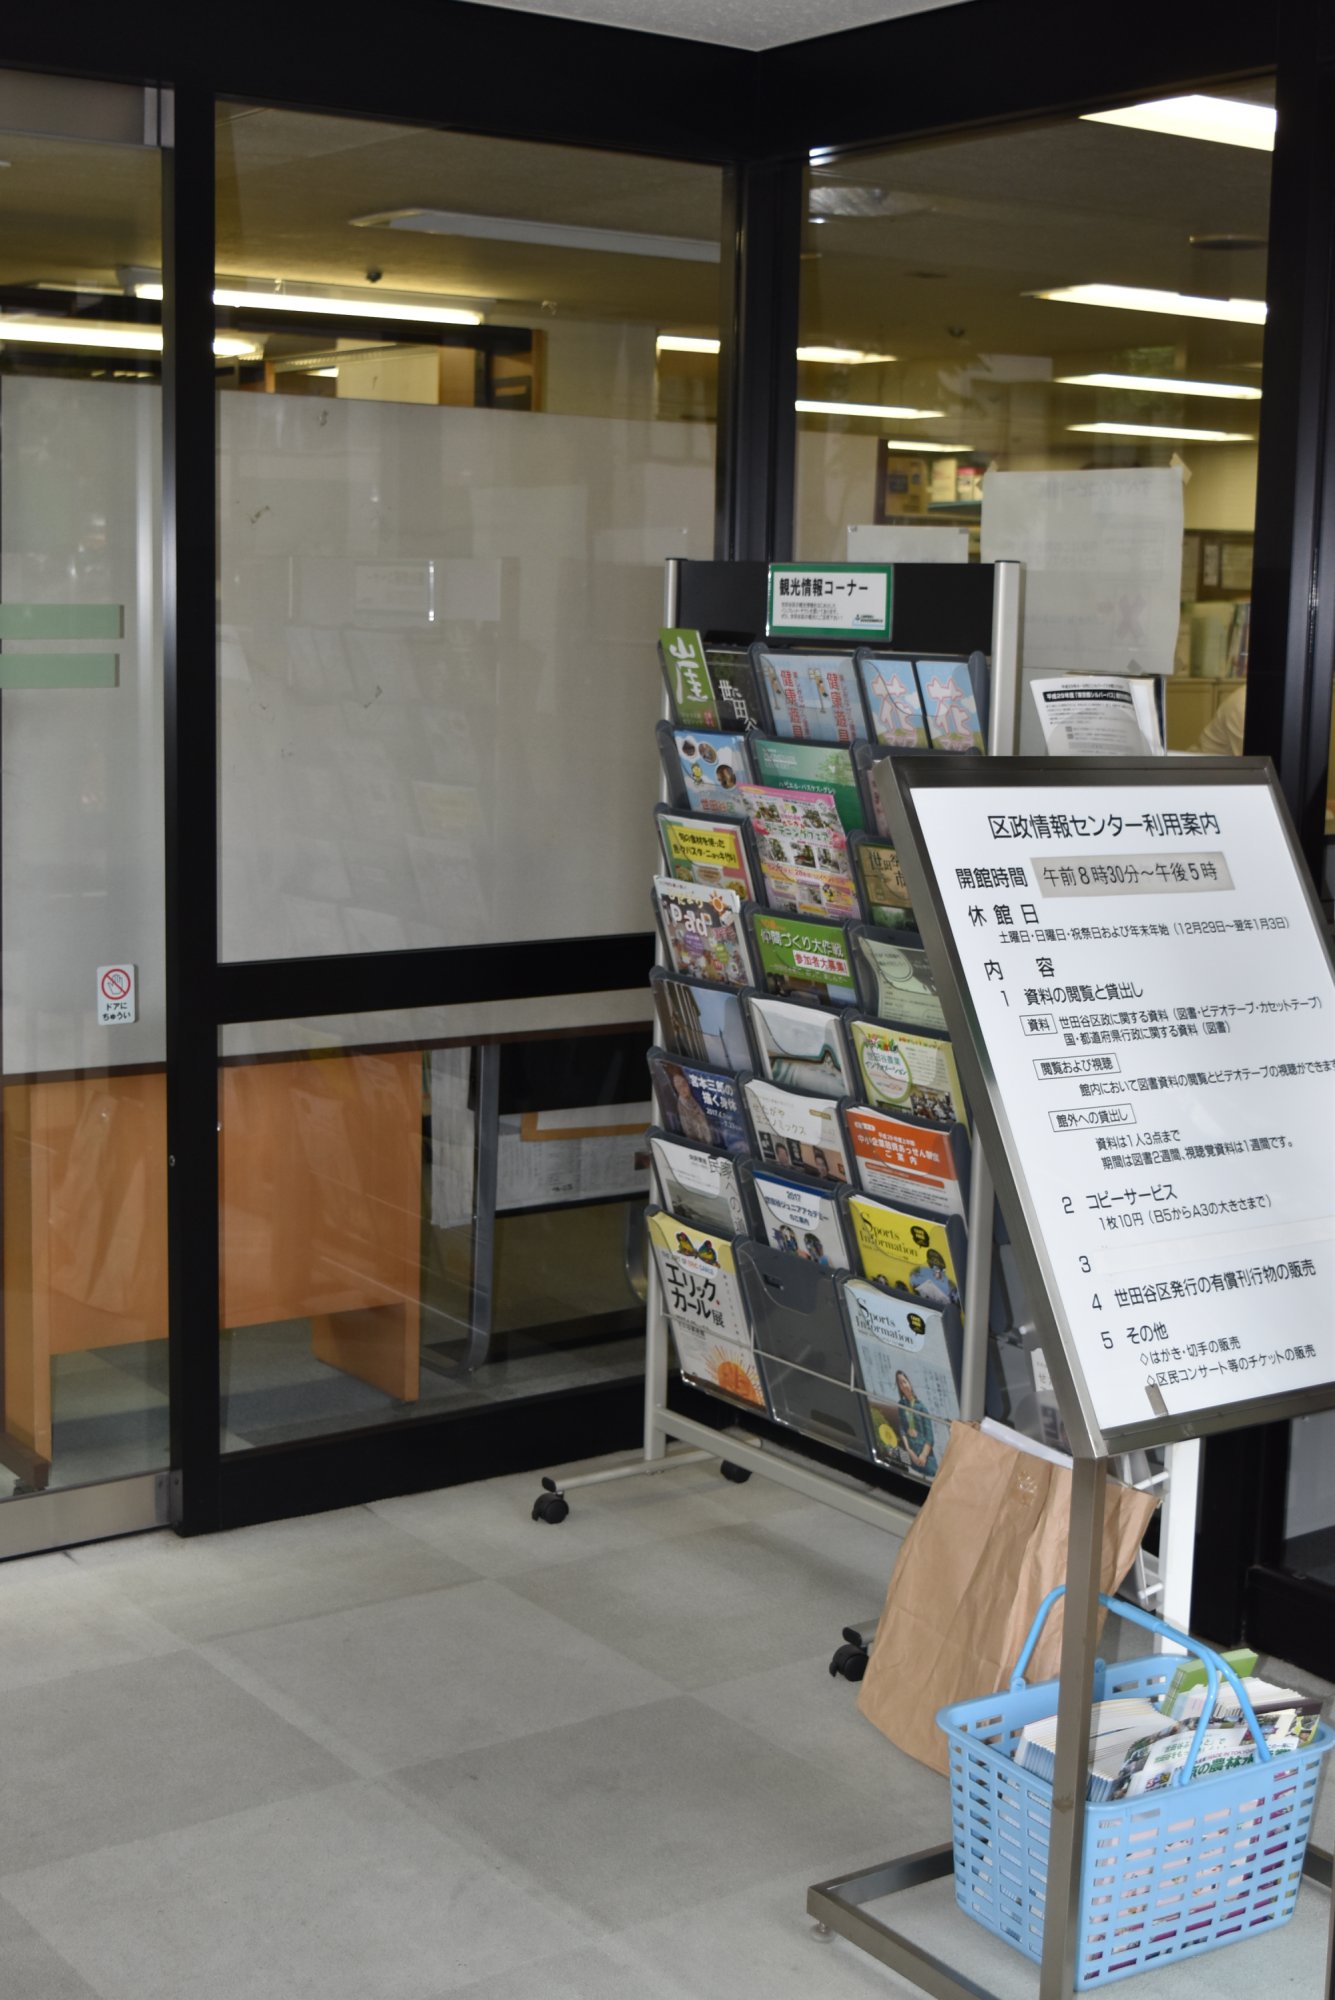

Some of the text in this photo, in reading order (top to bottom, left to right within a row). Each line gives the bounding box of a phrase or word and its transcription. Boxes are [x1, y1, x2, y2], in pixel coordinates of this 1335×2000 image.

[779, 578, 868, 597] 観光情報コーナー
[987, 811, 1221, 840] 区政情報センター利用案内
[955, 866, 1029, 890] 開館時間
[106, 1002, 128, 1010] ドアに
[1000, 980, 1144, 1007] 1 資料の閲覧と貸出し
[102, 1011, 131, 1021] ちゅうい
[1026, 1016, 1052, 1033] 資料
[1040, 1056, 1114, 1077] 閲覧および視聴
[1055, 1109, 1129, 1129] 館外への貸出し
[1095, 1129, 1181, 1151] 資料は1人3点まで
[1061, 1183, 1178, 1214] 2 コピーサービス
[860, 1212, 900, 1241] Sports
[859, 1230, 918, 1257] Information
[1078, 1255, 1092, 1273] 3
[1091, 1258, 1317, 1311] 4 世田谷区発行の有償刊行物の販売
[671, 1286, 725, 1329] カール展
[856, 1297, 896, 1328] Sports
[855, 1315, 914, 1345] Information
[1100, 1321, 1169, 1350] 5 その他
